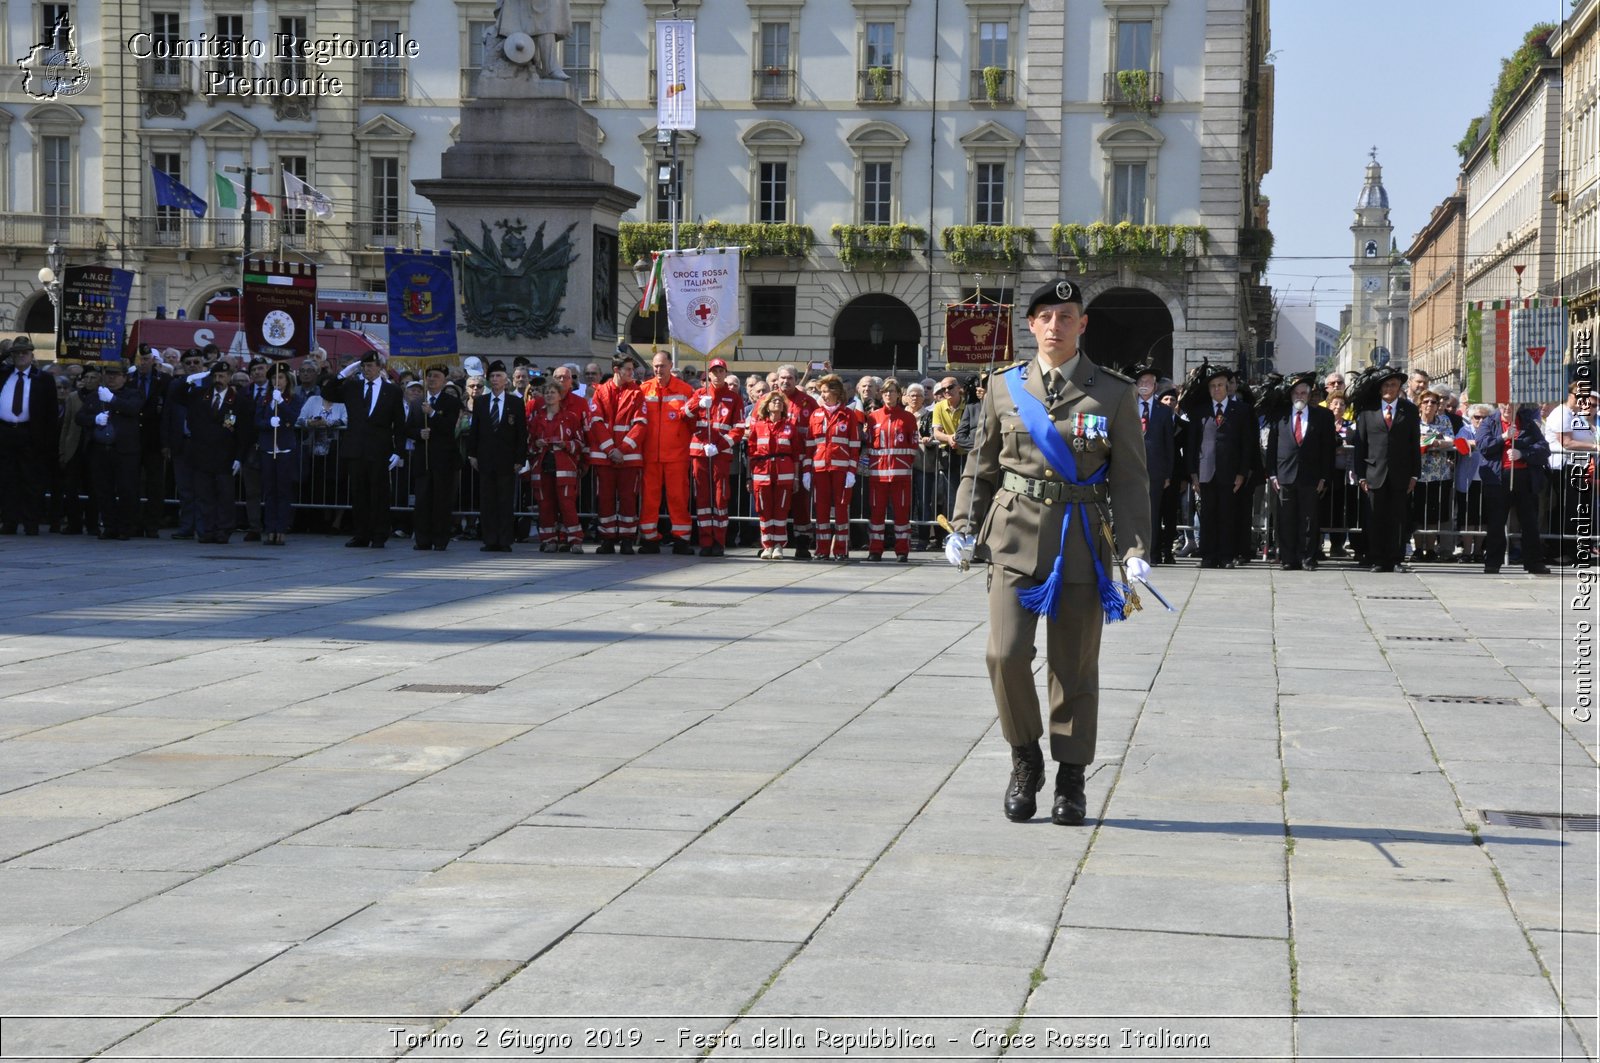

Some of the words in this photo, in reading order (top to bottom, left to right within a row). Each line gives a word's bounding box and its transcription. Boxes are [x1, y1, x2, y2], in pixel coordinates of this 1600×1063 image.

[665, 25, 673, 82] LEONARDO
[678, 66, 685, 82] DA
[673, 271, 699, 279] CROCE
[702, 269, 728, 277] ROSSA
[684, 277, 718, 287] ITALIANA
